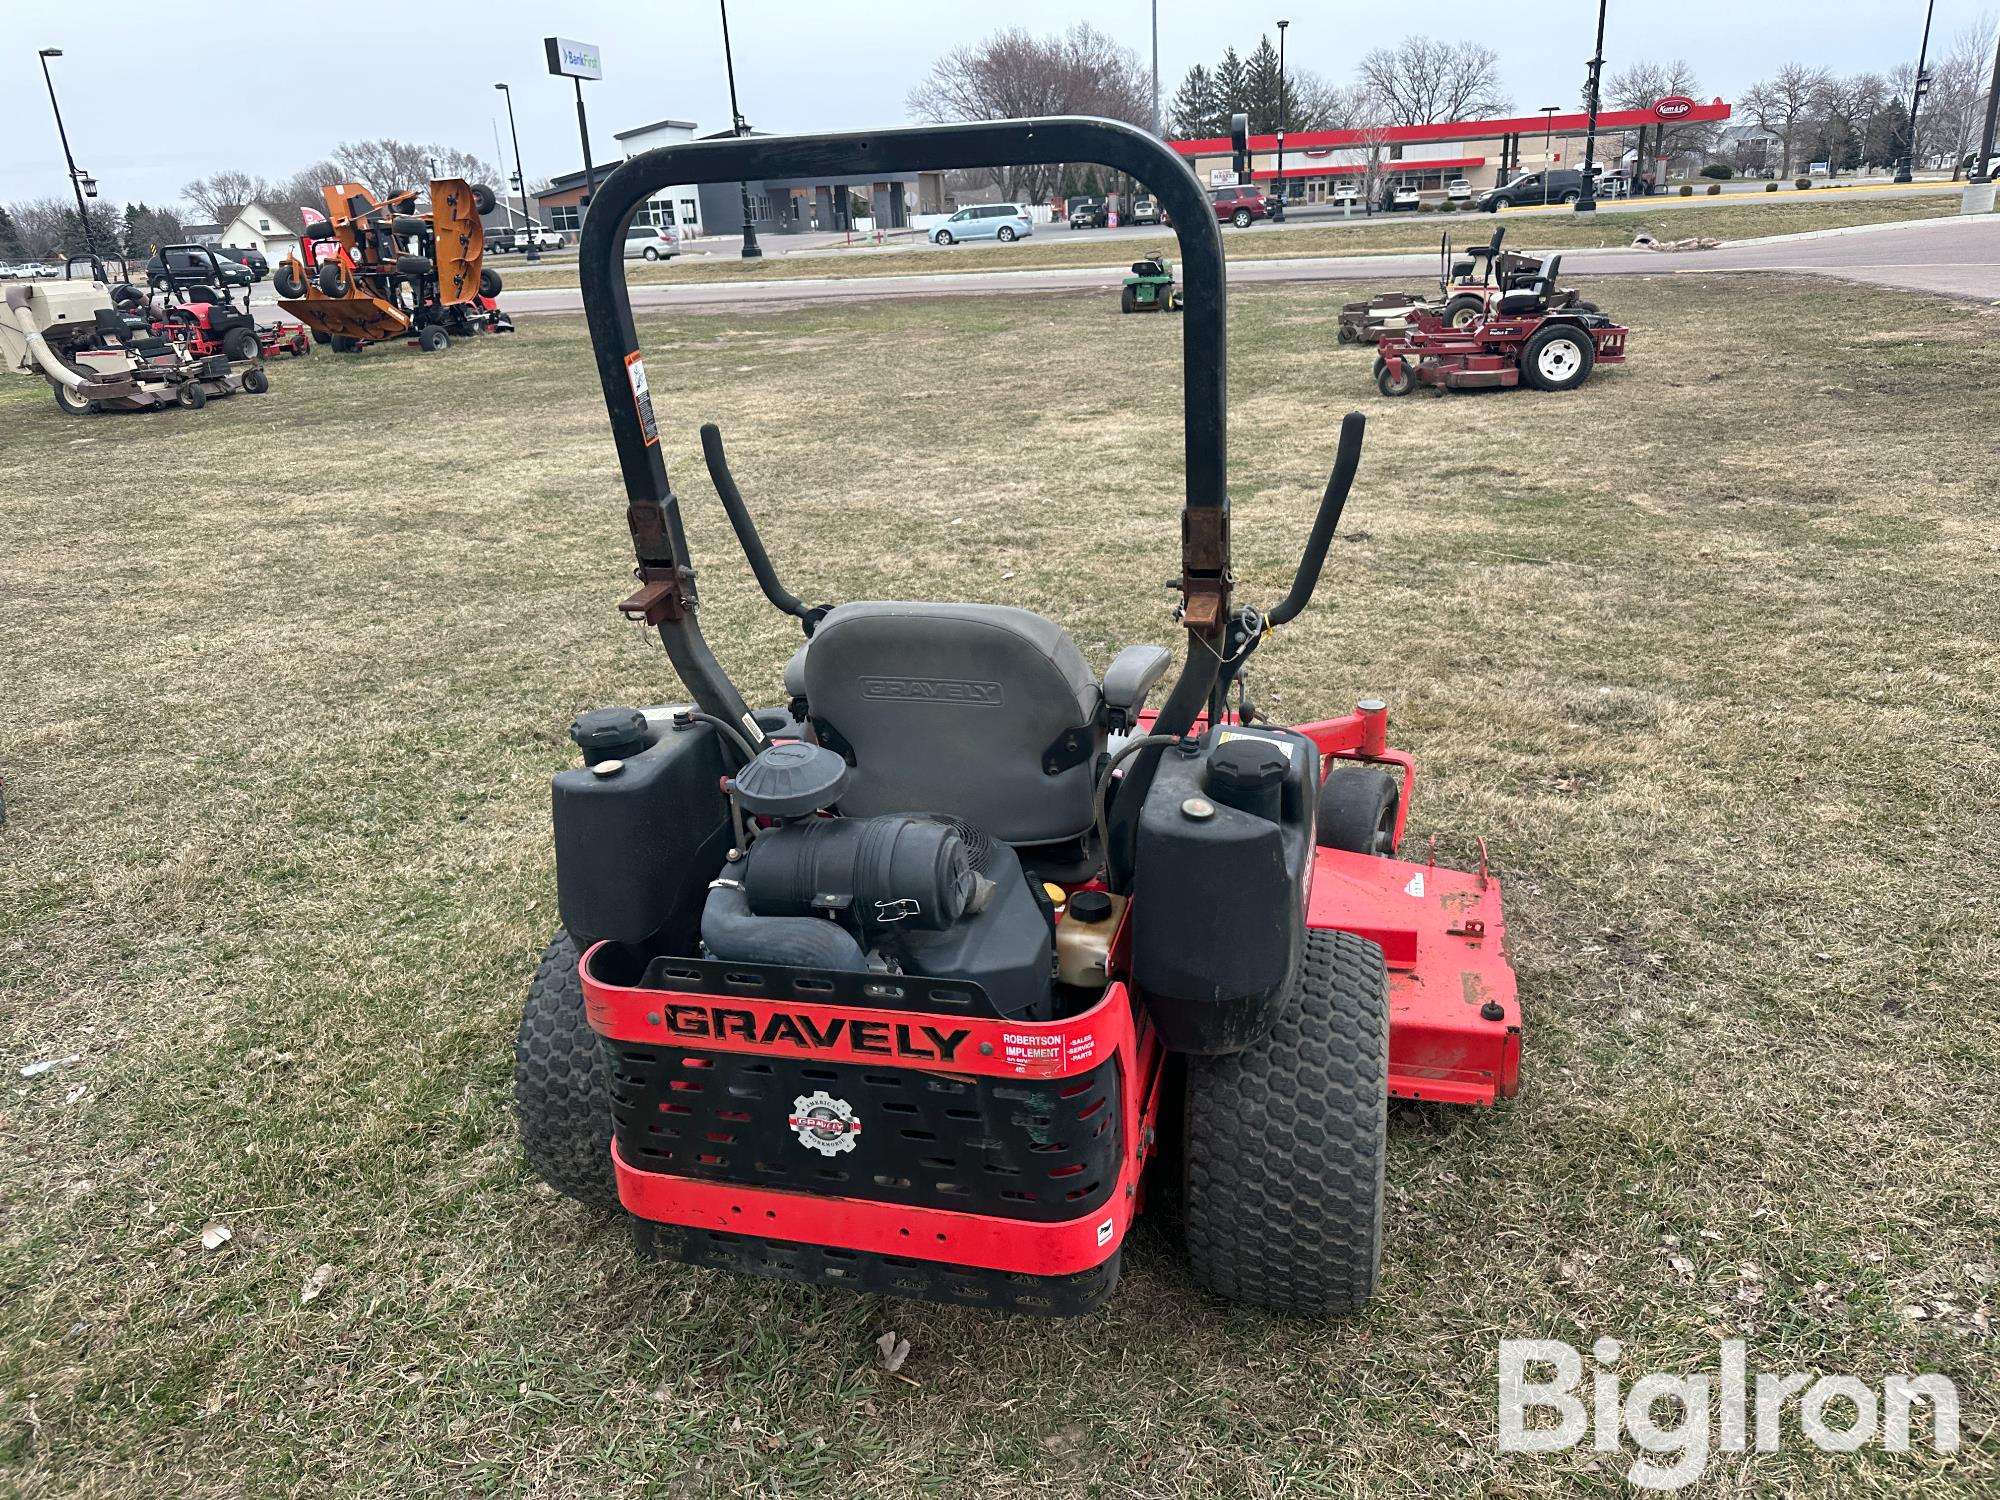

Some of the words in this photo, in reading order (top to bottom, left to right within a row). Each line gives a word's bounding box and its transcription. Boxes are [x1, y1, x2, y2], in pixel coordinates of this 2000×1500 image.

[865, 680, 996, 702] GRAVELY
[664, 1004, 971, 1062] GRAVELY
[1003, 1034, 1061, 1045] ROBERTSON
[1006, 1046, 1060, 1058] IMPLEMENT
[806, 1100, 840, 1112] AMERICAN
[798, 1119, 844, 1130] GRAVELY
[808, 1134, 846, 1147] WORKHORSE
